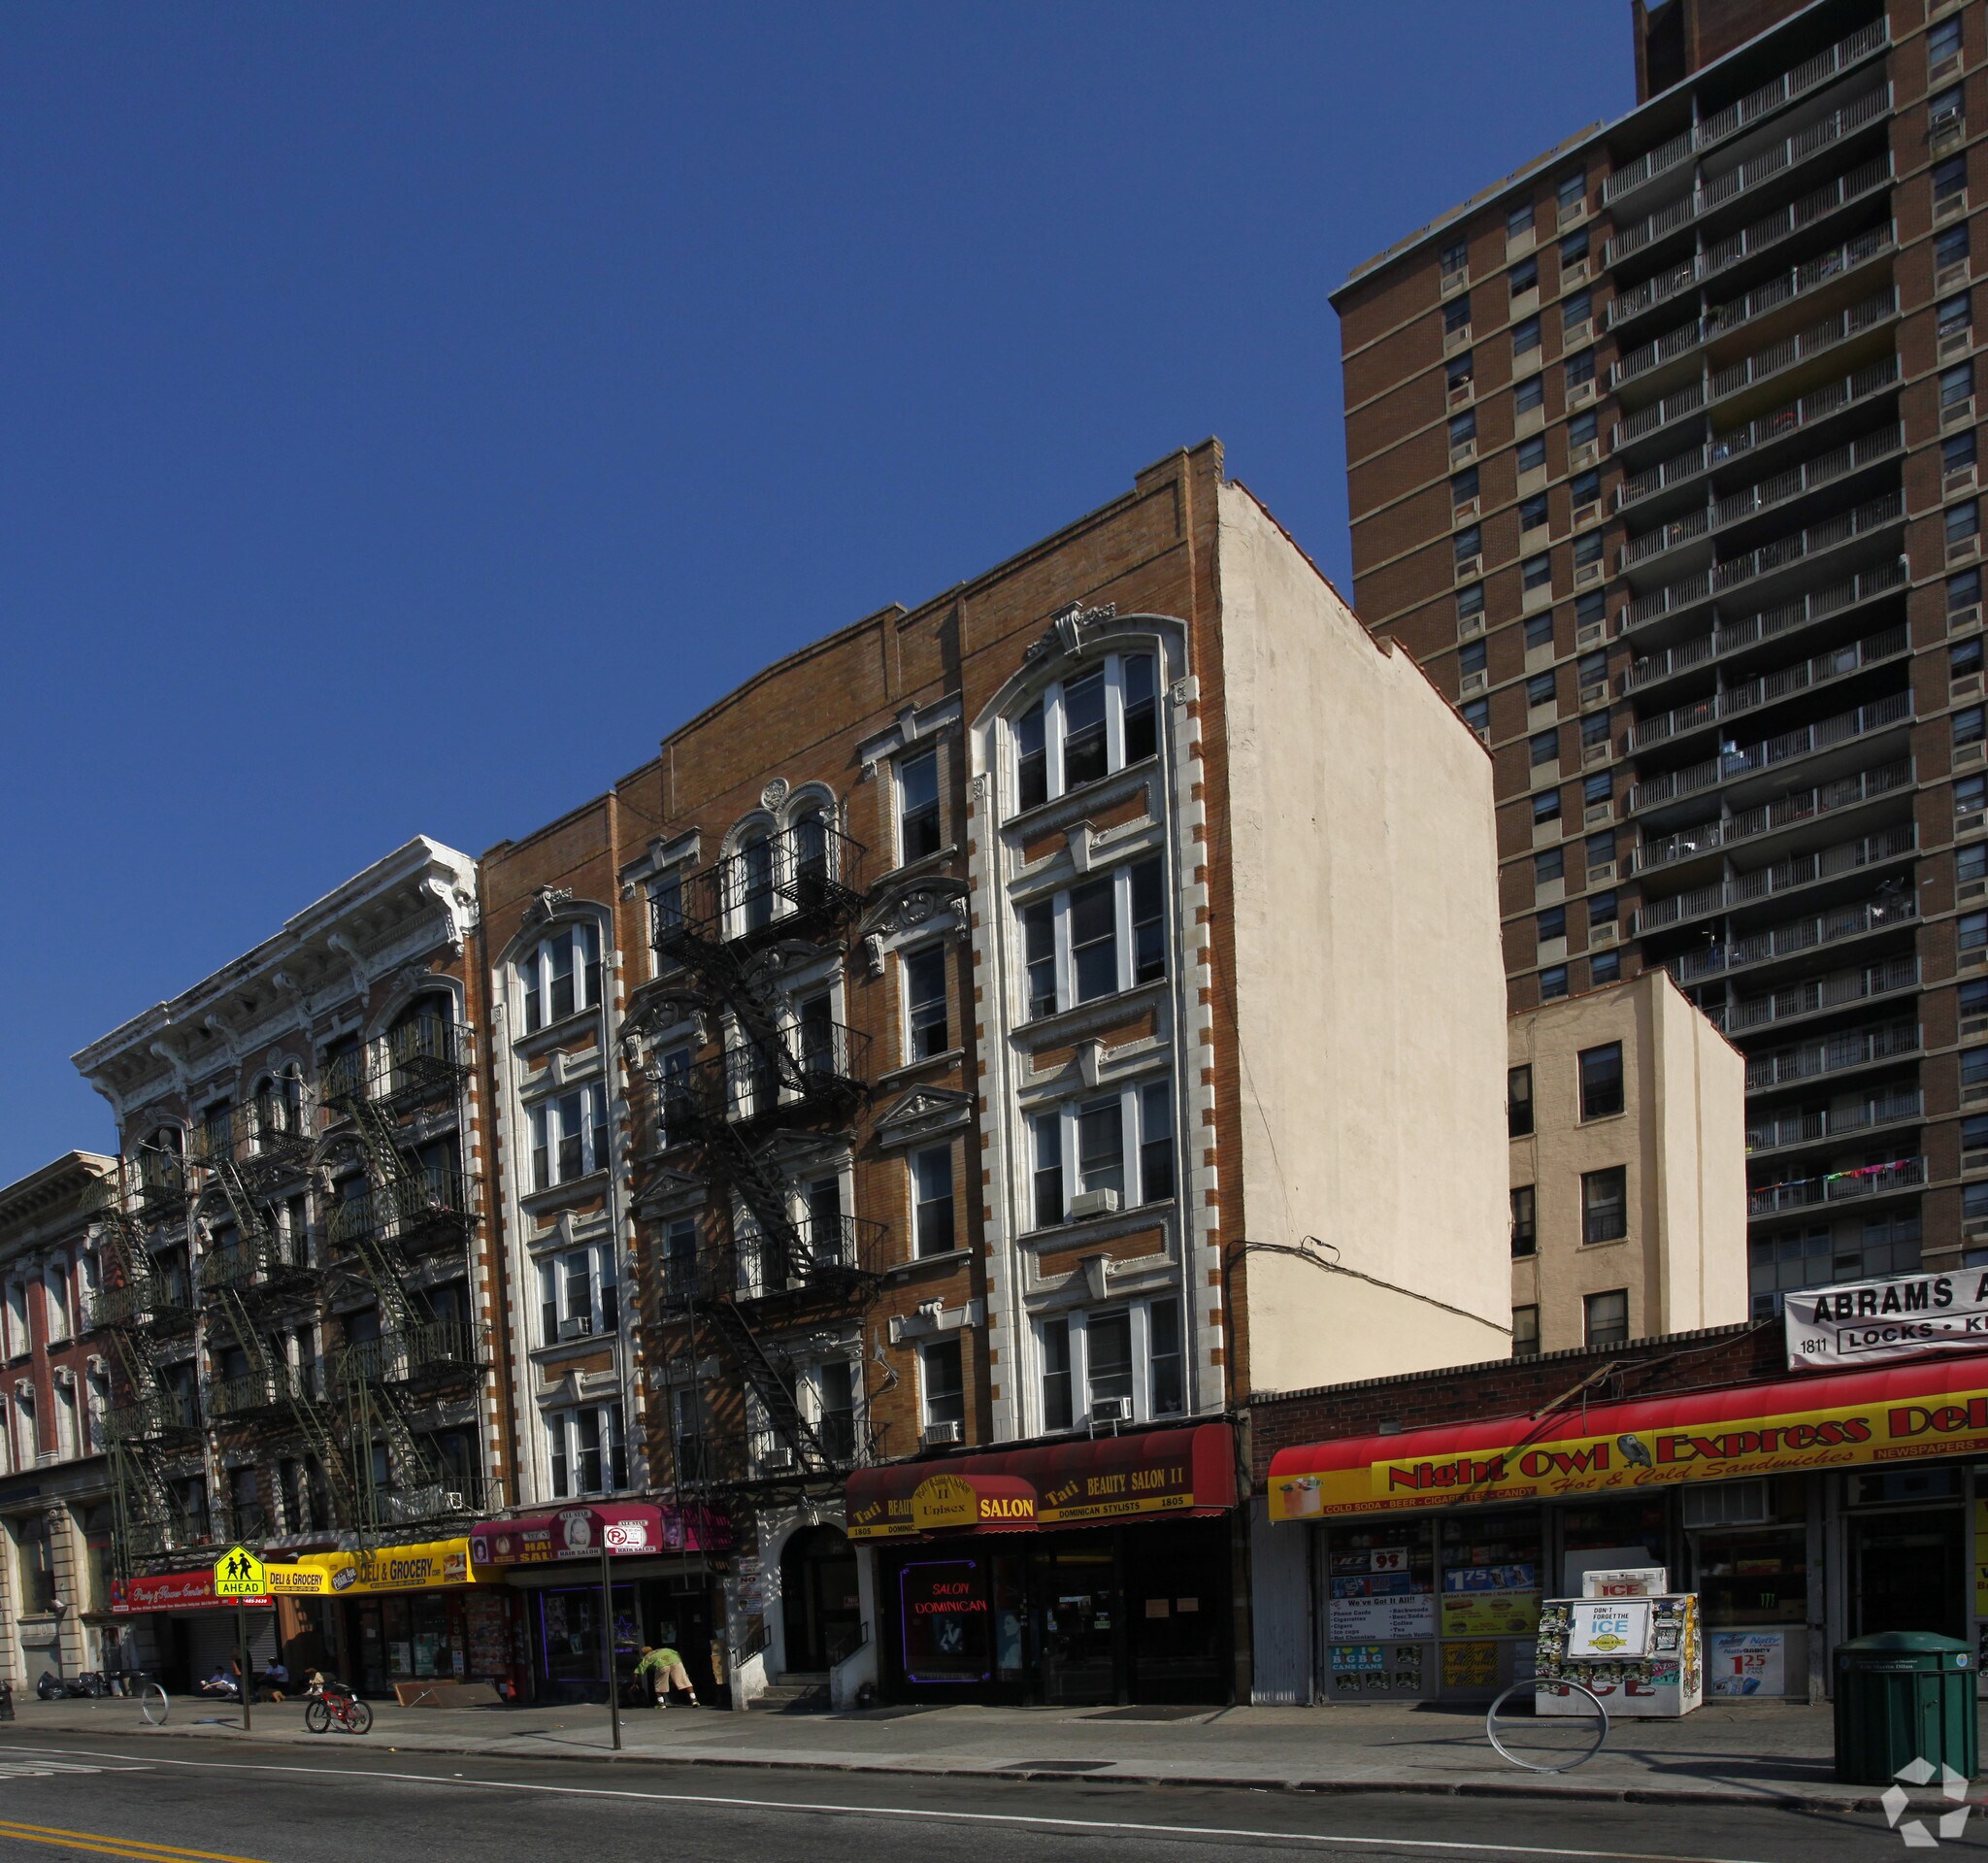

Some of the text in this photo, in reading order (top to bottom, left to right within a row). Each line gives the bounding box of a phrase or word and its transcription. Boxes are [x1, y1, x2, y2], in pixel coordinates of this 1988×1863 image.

[1812, 1278, 1953, 1324] ABRAMS
[1849, 1323, 1934, 1347] LOCKS
[1801, 1338, 1827, 1354] 1811
[1389, 1453, 1508, 1491] Night
[1520, 1442, 1609, 1477] Owl
[1656, 1417, 1872, 1464] Express
[1877, 1440, 1975, 1459] NEWSPAPERS
[1550, 1448, 1856, 1492] Hot & Cold Sandwiches
[939, 1488, 947, 1499] II
[1044, 1467, 1183, 1506] Tati BEAUTY SALON II
[1162, 1496, 1183, 1507] 1805
[1326, 1504, 1353, 1514] COLD
[1354, 1501, 1381, 1511] SODA
[1389, 1498, 1416, 1508] BEER
[1497, 1487, 1535, 1499] CANDY
[853, 1498, 913, 1524] Tati BEAUT
[923, 1504, 965, 1516] Unisex
[979, 1499, 1034, 1517] SALON
[1059, 1502, 1140, 1518] DOMINICAN STYLISTS
[854, 1527, 872, 1536] 1805
[524, 1541, 551, 1551] HAI
[519, 1551, 550, 1562] SAL
[361, 1563, 380, 1582] DELI
[381, 1562, 388, 1580] &
[390, 1557, 434, 1580] GROCERY
[270, 1572, 323, 1585] DELI & GROCERY
[223, 1583, 259, 1593] AHEAD
[932, 1582, 970, 1595] SALON
[1602, 1583, 1640, 1596] ICE
[914, 1600, 988, 1613] DOMINICAN
[1591, 1620, 1629, 1633] ICE
